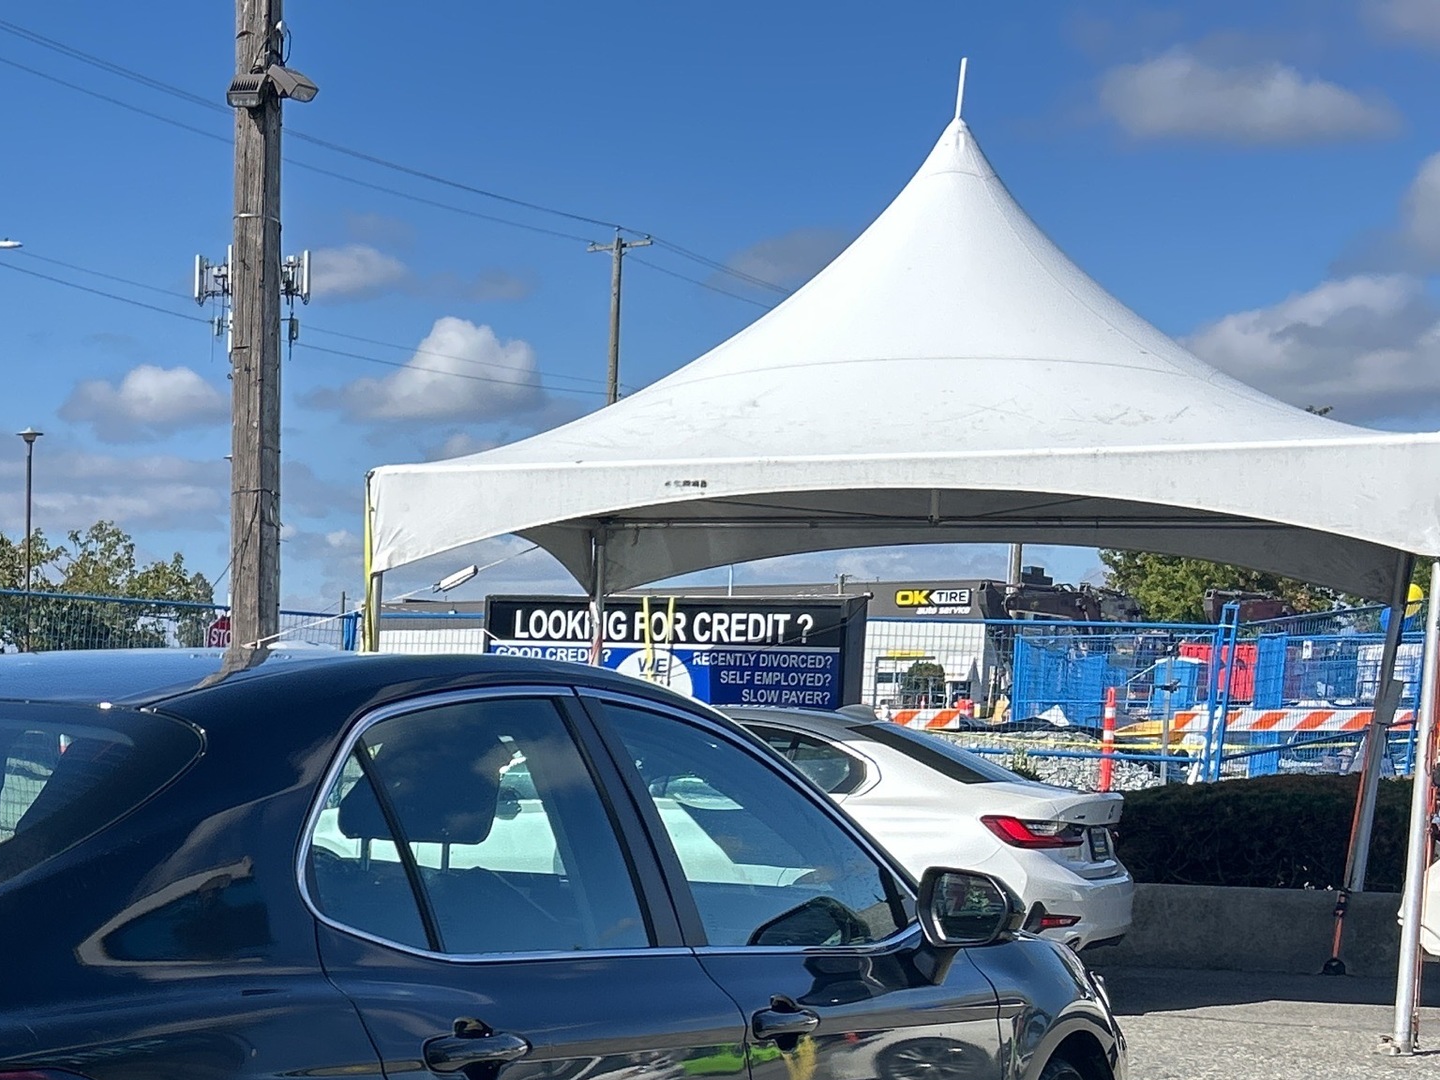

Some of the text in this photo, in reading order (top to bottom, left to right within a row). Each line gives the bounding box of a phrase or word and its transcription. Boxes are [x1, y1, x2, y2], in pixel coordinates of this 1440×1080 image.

[896, 590, 967, 605] OK TIRE
[916, 606, 971, 615] auto service
[514, 609, 814, 644] LOOKING FOR CREDIT ?
[210, 627, 232, 646] STO
[692, 651, 833, 669] RECENTLY DIVORCED?
[720, 670, 832, 687] SELF EMPLOYED?
[741, 688, 831, 705] SLOW PAYER?
